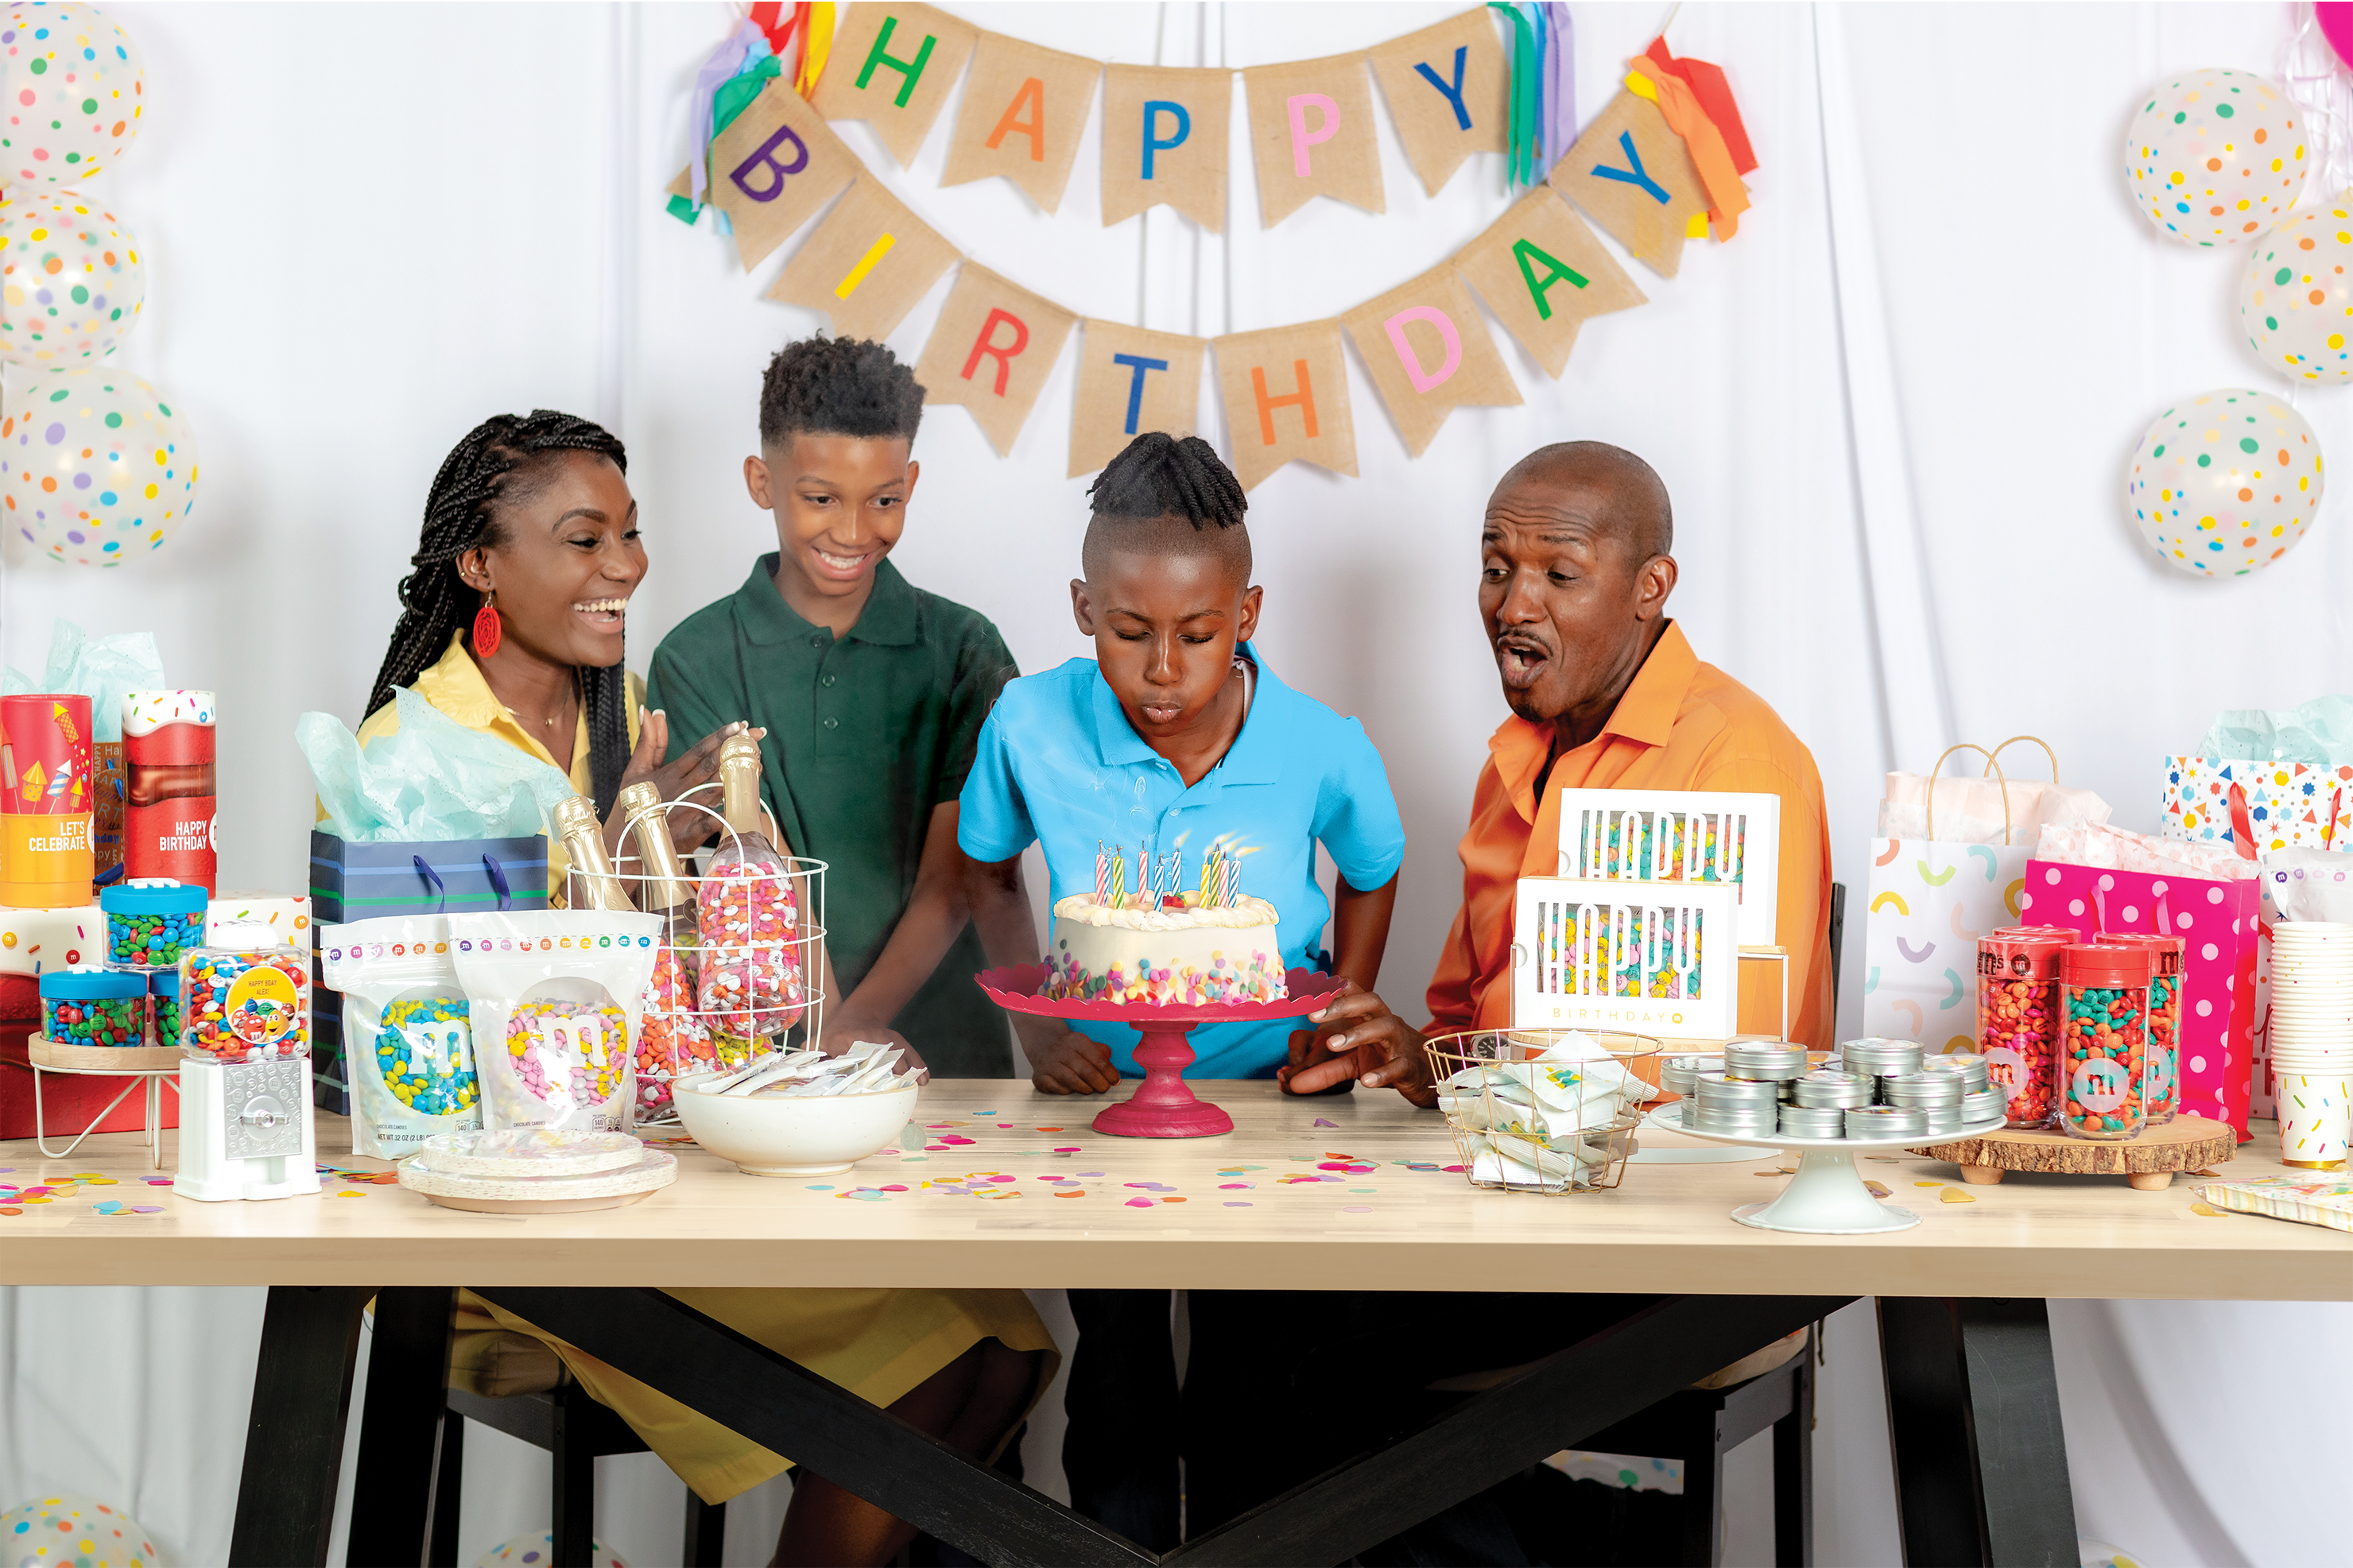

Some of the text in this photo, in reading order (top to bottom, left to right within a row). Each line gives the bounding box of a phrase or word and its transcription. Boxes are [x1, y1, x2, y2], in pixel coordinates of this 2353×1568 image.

[855, 16, 1473, 180] HAPPY
[729, 123, 1671, 447] BIRTHDAY
[60, 821, 85, 836] LET'S
[175, 820, 207, 836] HAPPY
[29, 837, 85, 852] CELEBRATE
[159, 835, 207, 852] BIRTHDAY
[1585, 809, 1740, 881] HAPPY
[1543, 901, 1698, 1000] HAPPY
[1553, 1007, 1665, 1023] BIRTHDAY
[250, 1032, 262, 1041] m
[406, 1019, 474, 1074] m
[538, 1015, 607, 1067] m
[1989, 1063, 2015, 1086] m
[2087, 1074, 2116, 1096] m
